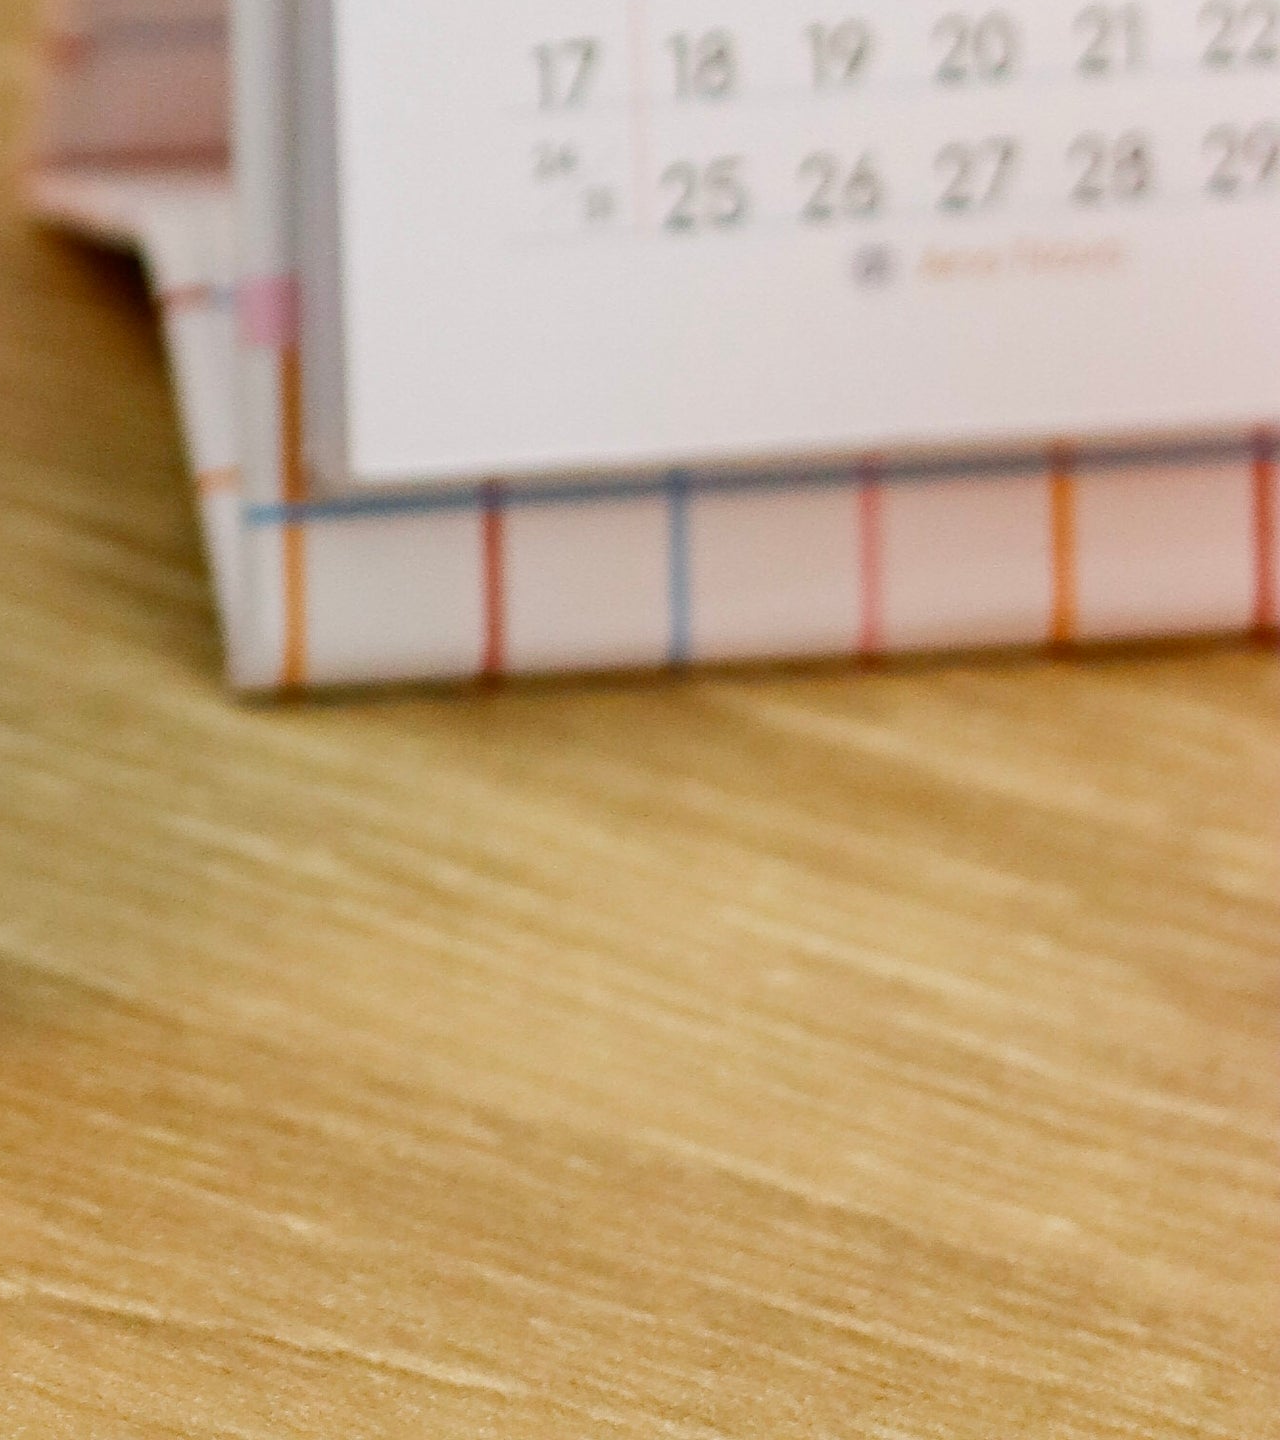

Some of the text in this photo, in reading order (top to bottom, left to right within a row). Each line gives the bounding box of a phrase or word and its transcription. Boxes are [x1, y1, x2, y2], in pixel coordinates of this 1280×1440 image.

[534, 35, 599, 110] 17
[669, 29, 736, 101] 18
[806, 20, 875, 86] 19
[932, 11, 1019, 87] 20
[1075, 4, 1142, 77] 21
[662, 156, 748, 235] 25
[799, 151, 884, 224] 26
[936, 137, 1017, 215] 27
[1069, 133, 1152, 206] 28
[1203, 125, 1280, 198] 29
